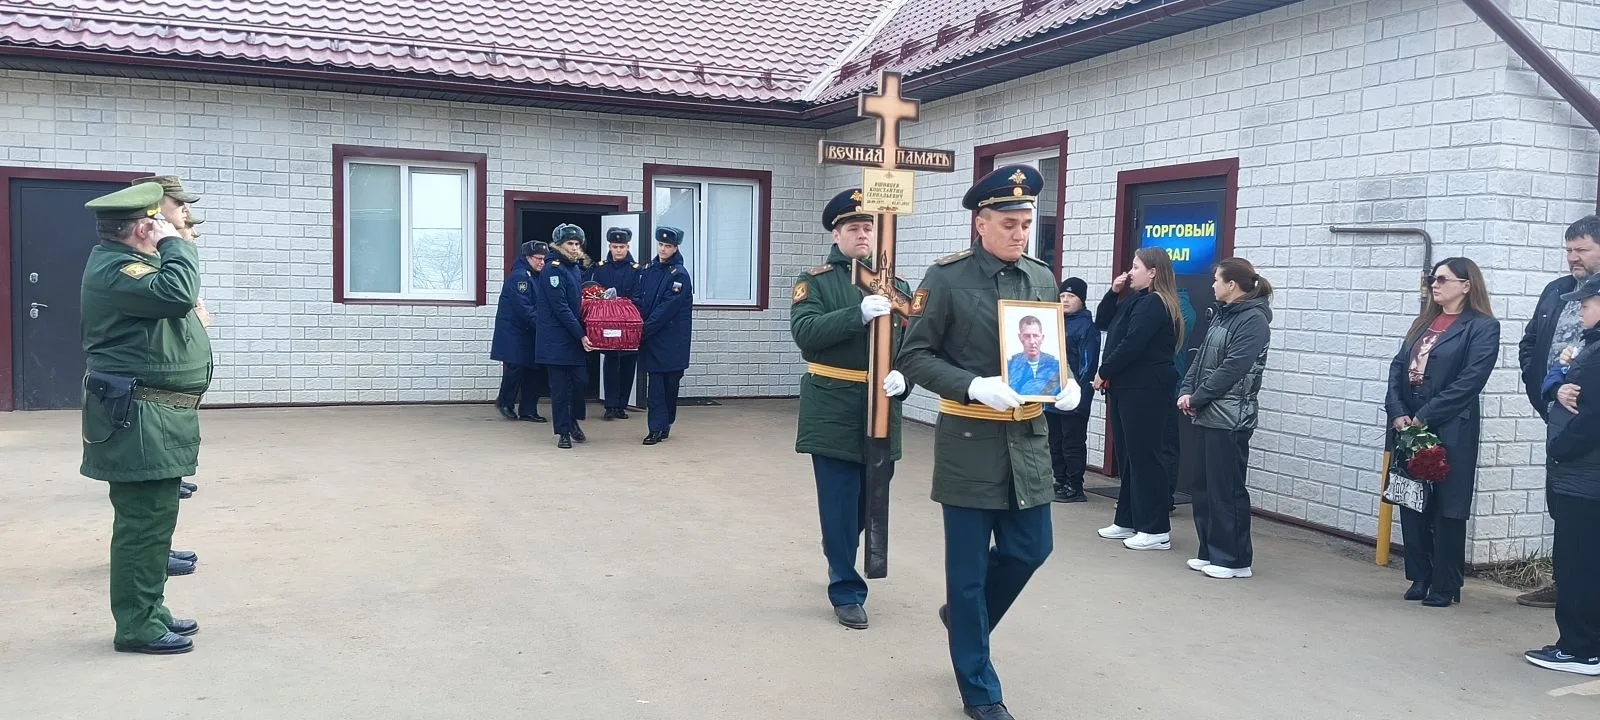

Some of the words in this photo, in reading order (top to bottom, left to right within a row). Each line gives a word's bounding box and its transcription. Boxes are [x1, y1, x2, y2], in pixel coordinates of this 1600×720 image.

[828, 145, 884, 163] ВЕЧНАЯ
[896, 149, 950, 167] ПАМЯТЬ
[1145, 220, 1215, 238] ТОРГОВЫЙ
